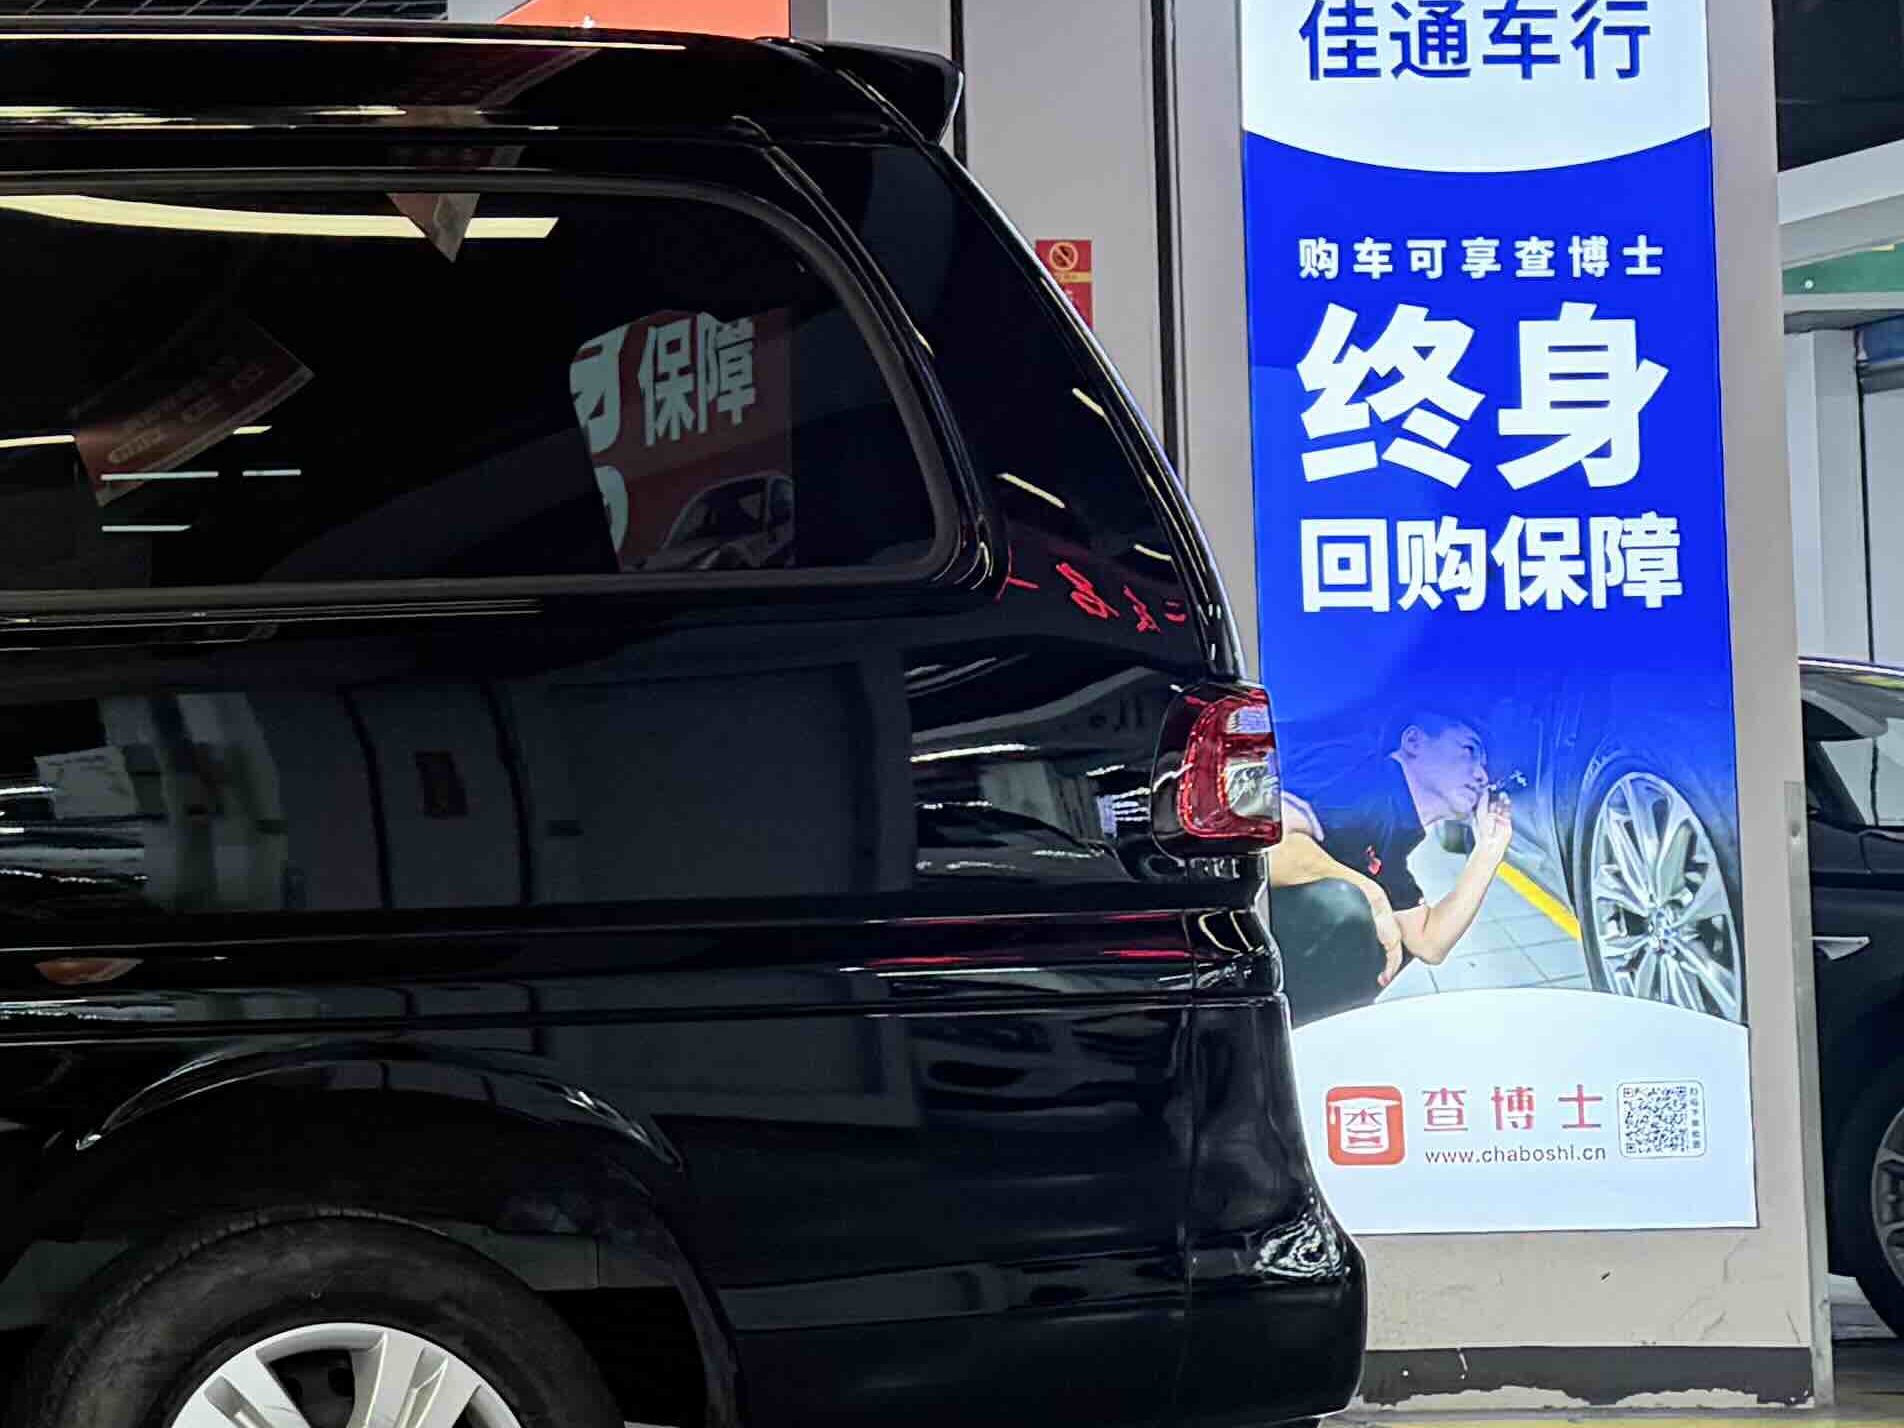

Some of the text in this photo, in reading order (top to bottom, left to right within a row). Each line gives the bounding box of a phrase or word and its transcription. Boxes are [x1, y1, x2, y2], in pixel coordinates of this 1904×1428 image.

[1297, 235, 1665, 280] 购车可享查博士
[1296, 301, 1670, 490] 终身
[1300, 512, 1684, 614] 回购保障
[1421, 1083, 1604, 1132] 查博士
[1424, 1143, 1607, 1165] www.chaboshi.cn
